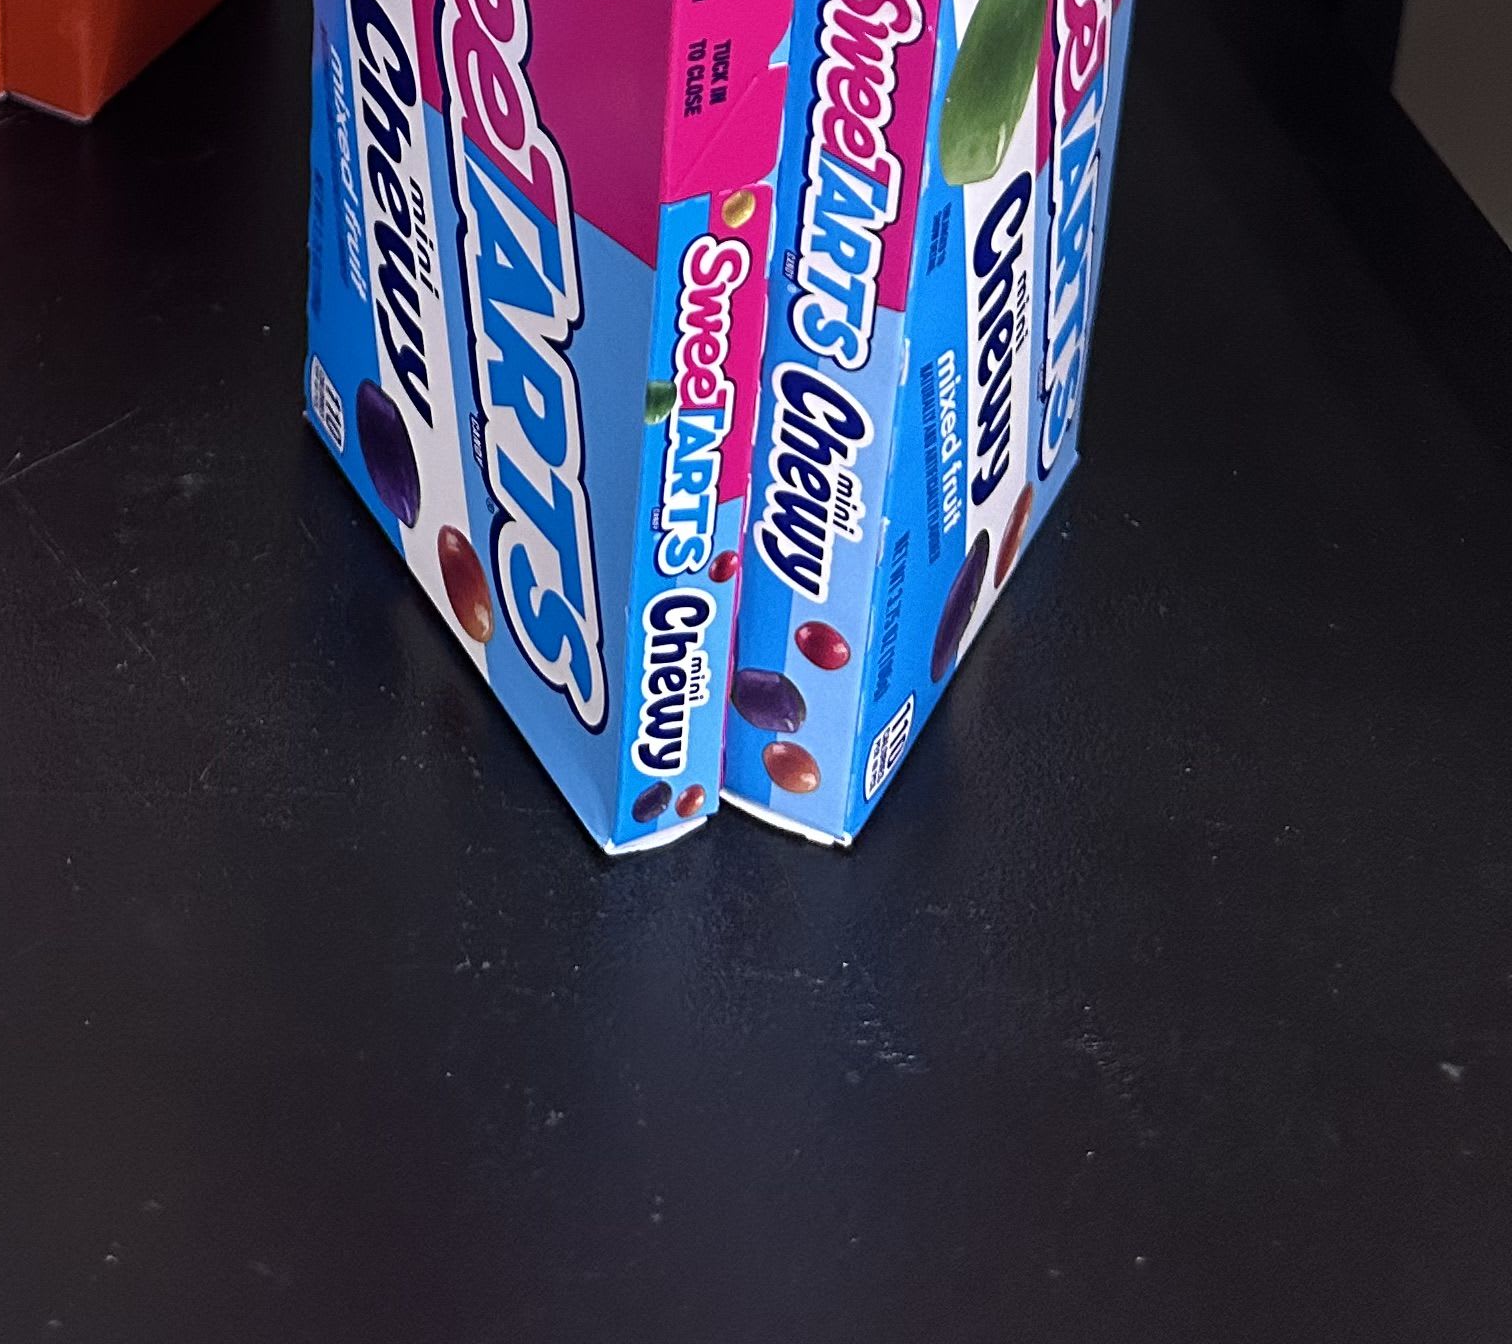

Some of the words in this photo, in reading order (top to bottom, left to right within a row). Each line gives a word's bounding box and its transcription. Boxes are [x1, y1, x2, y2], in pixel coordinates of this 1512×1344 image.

[687, 38, 708, 62] TO
[710, 38, 732, 85] TUCK
[329, 43, 360, 199] mixed
[683, 64, 706, 118] CLOSE
[709, 86, 728, 105] IN
[343, 198, 368, 303] fruit
[409, 174, 441, 301] mini
[972, 171, 1033, 506] Chewy
[1014, 269, 1030, 355] mini
[325, 385, 343, 448] 110
[919, 362, 938, 424] NATURALLY
[937, 349, 962, 458] mixed
[471, 417, 485, 468] CANDY
[758, 366, 866, 599] Chewy
[833, 472, 854, 534] mini
[941, 458, 963, 534] fruit
[640, 599, 710, 771] Chewy
[689, 654, 704, 702] mini
[887, 701, 912, 770] 110
